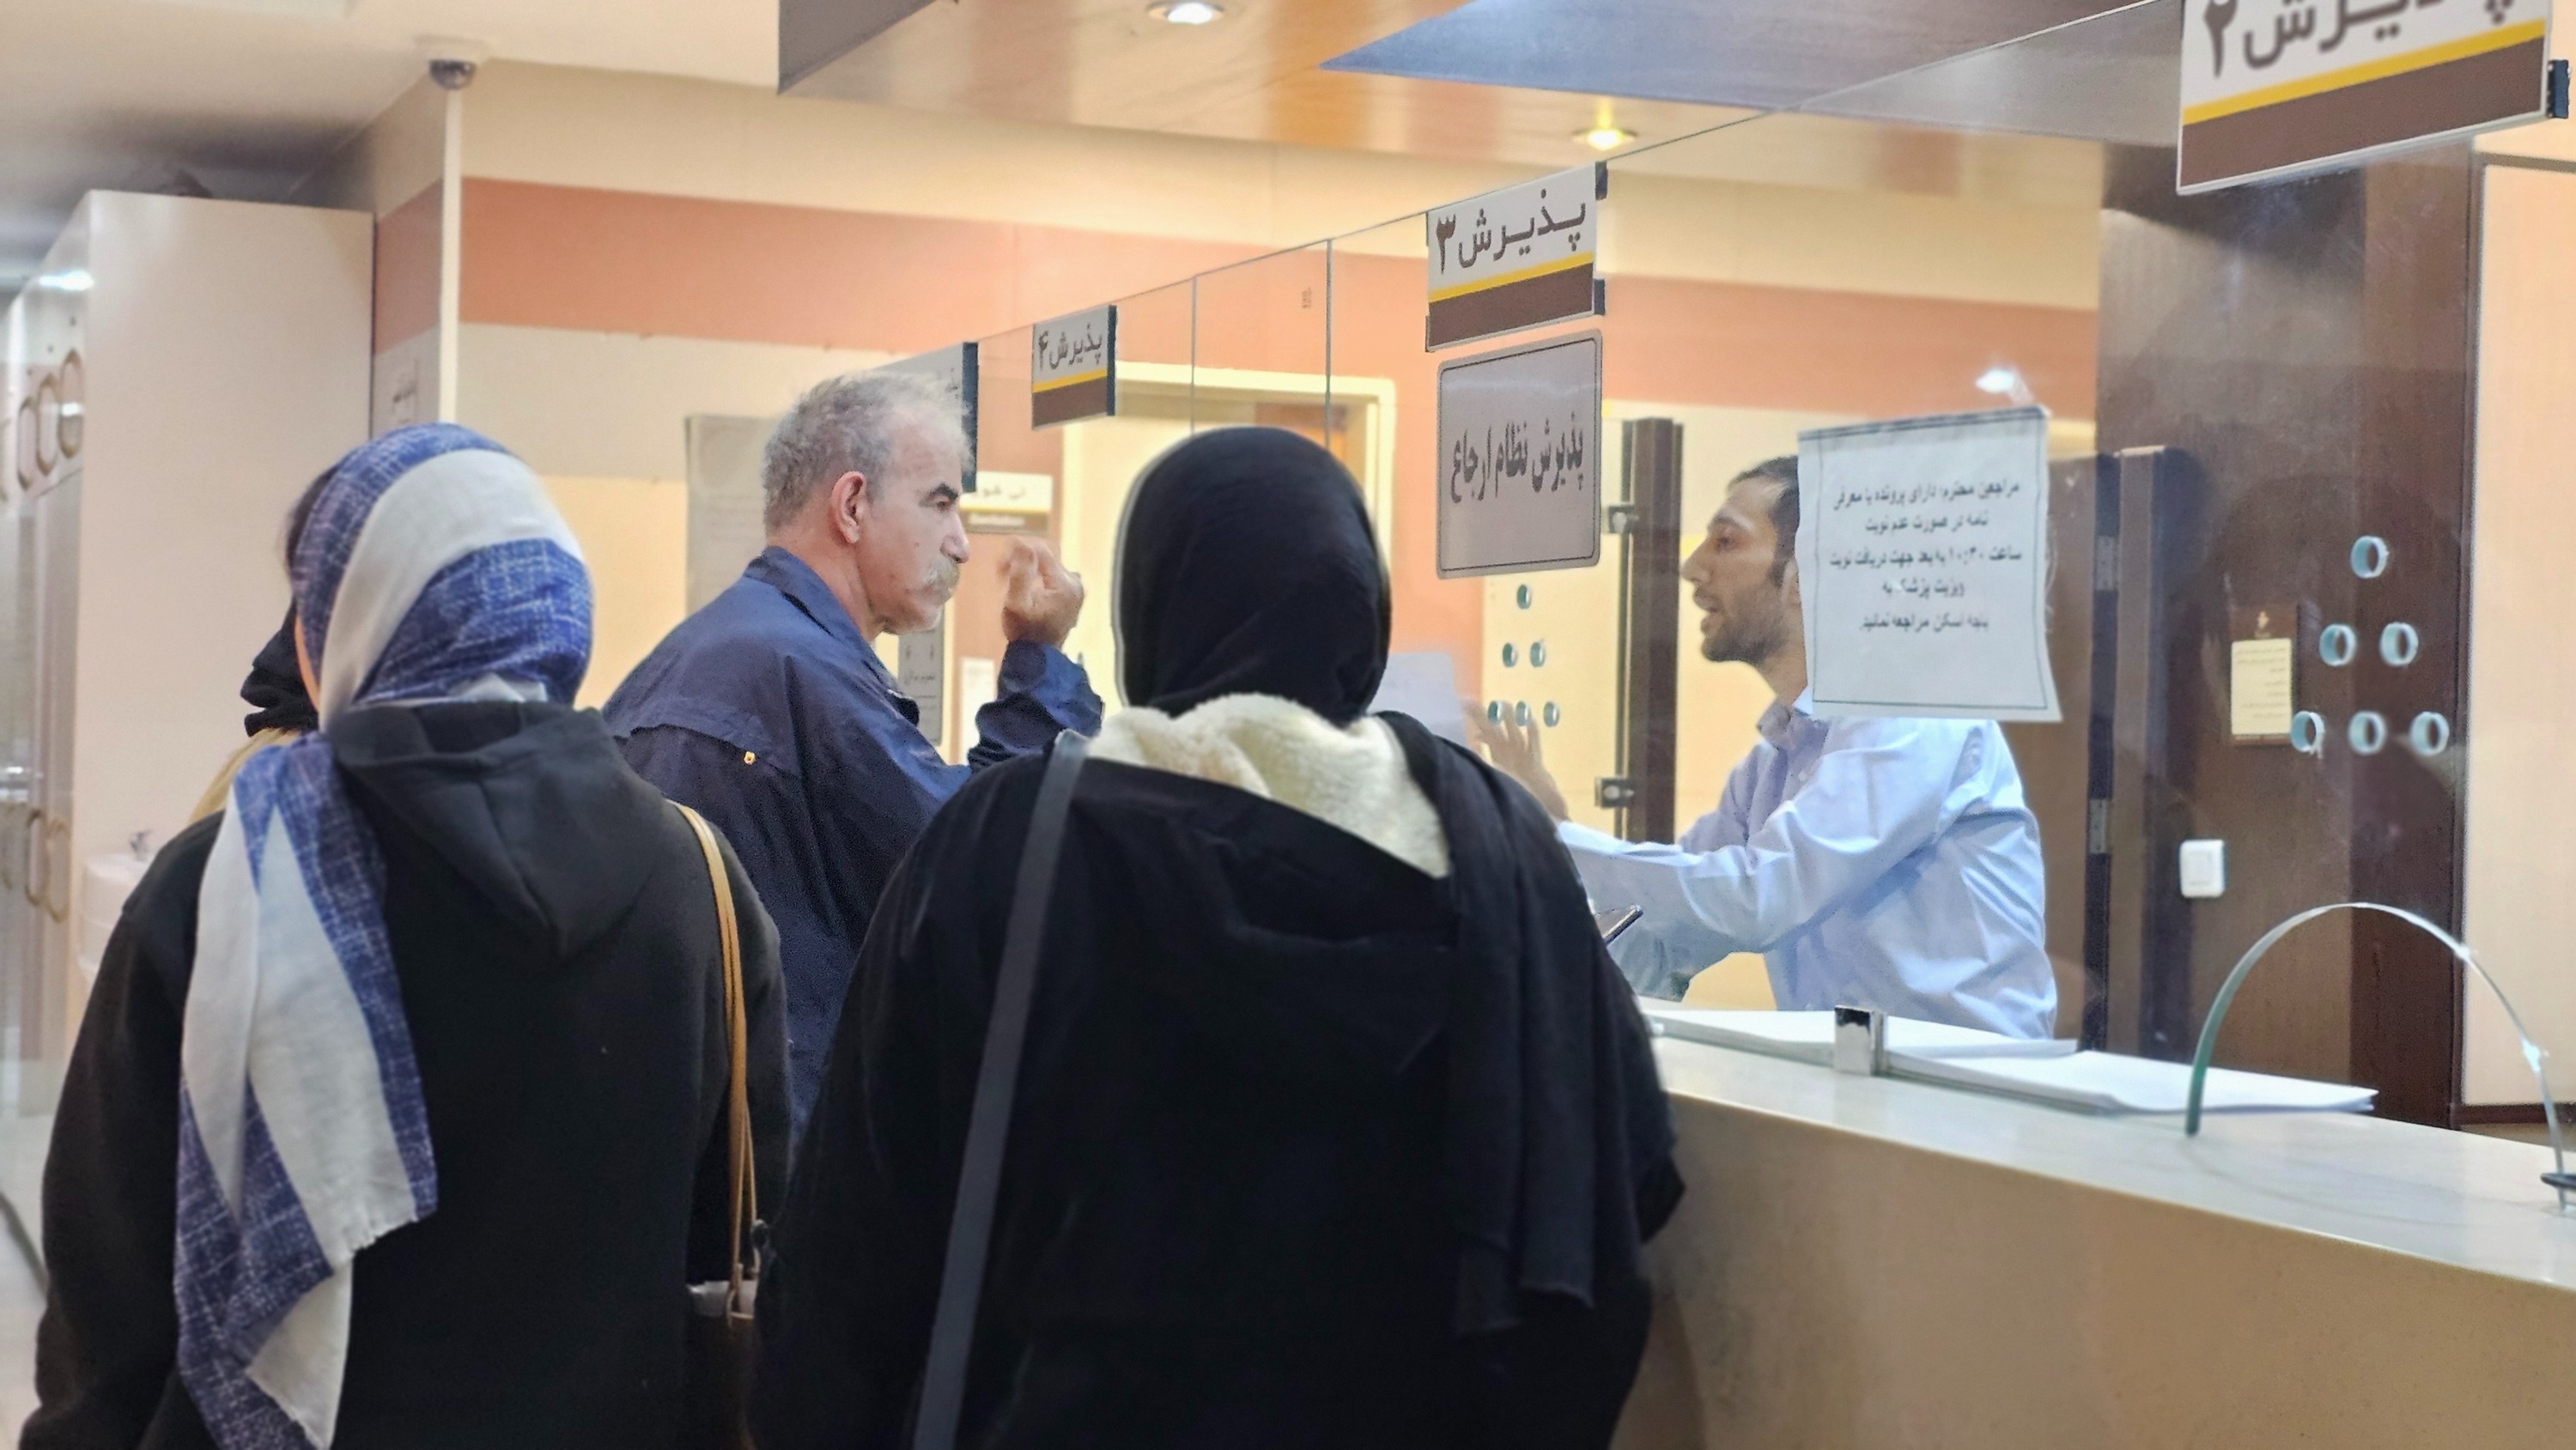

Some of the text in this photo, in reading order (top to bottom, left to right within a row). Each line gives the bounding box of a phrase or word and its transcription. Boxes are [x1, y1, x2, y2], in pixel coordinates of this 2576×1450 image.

[1450, 412, 1584, 503] پذیرش نظام ارجاع
[1833, 485, 1862, 510] معرفی
[1875, 484, 1905, 507] پرونده
[1909, 482, 1937, 504] دارای
[1978, 478, 2020, 500] مراجعین
[1866, 511, 1989, 536] نامه در صورت عدم نوبت
[1830, 551, 1852, 570] نوبت
[1855, 547, 1886, 569] دریافت
[1890, 550, 1914, 568] جهت
[1918, 550, 1933, 567] بعد
[1989, 545, 2021, 561] ساعت
[1935, 576, 1965, 598] ویزیت
[1893, 613, 1929, 633] مراجعه
[1934, 612, 1964, 633] اسکن
